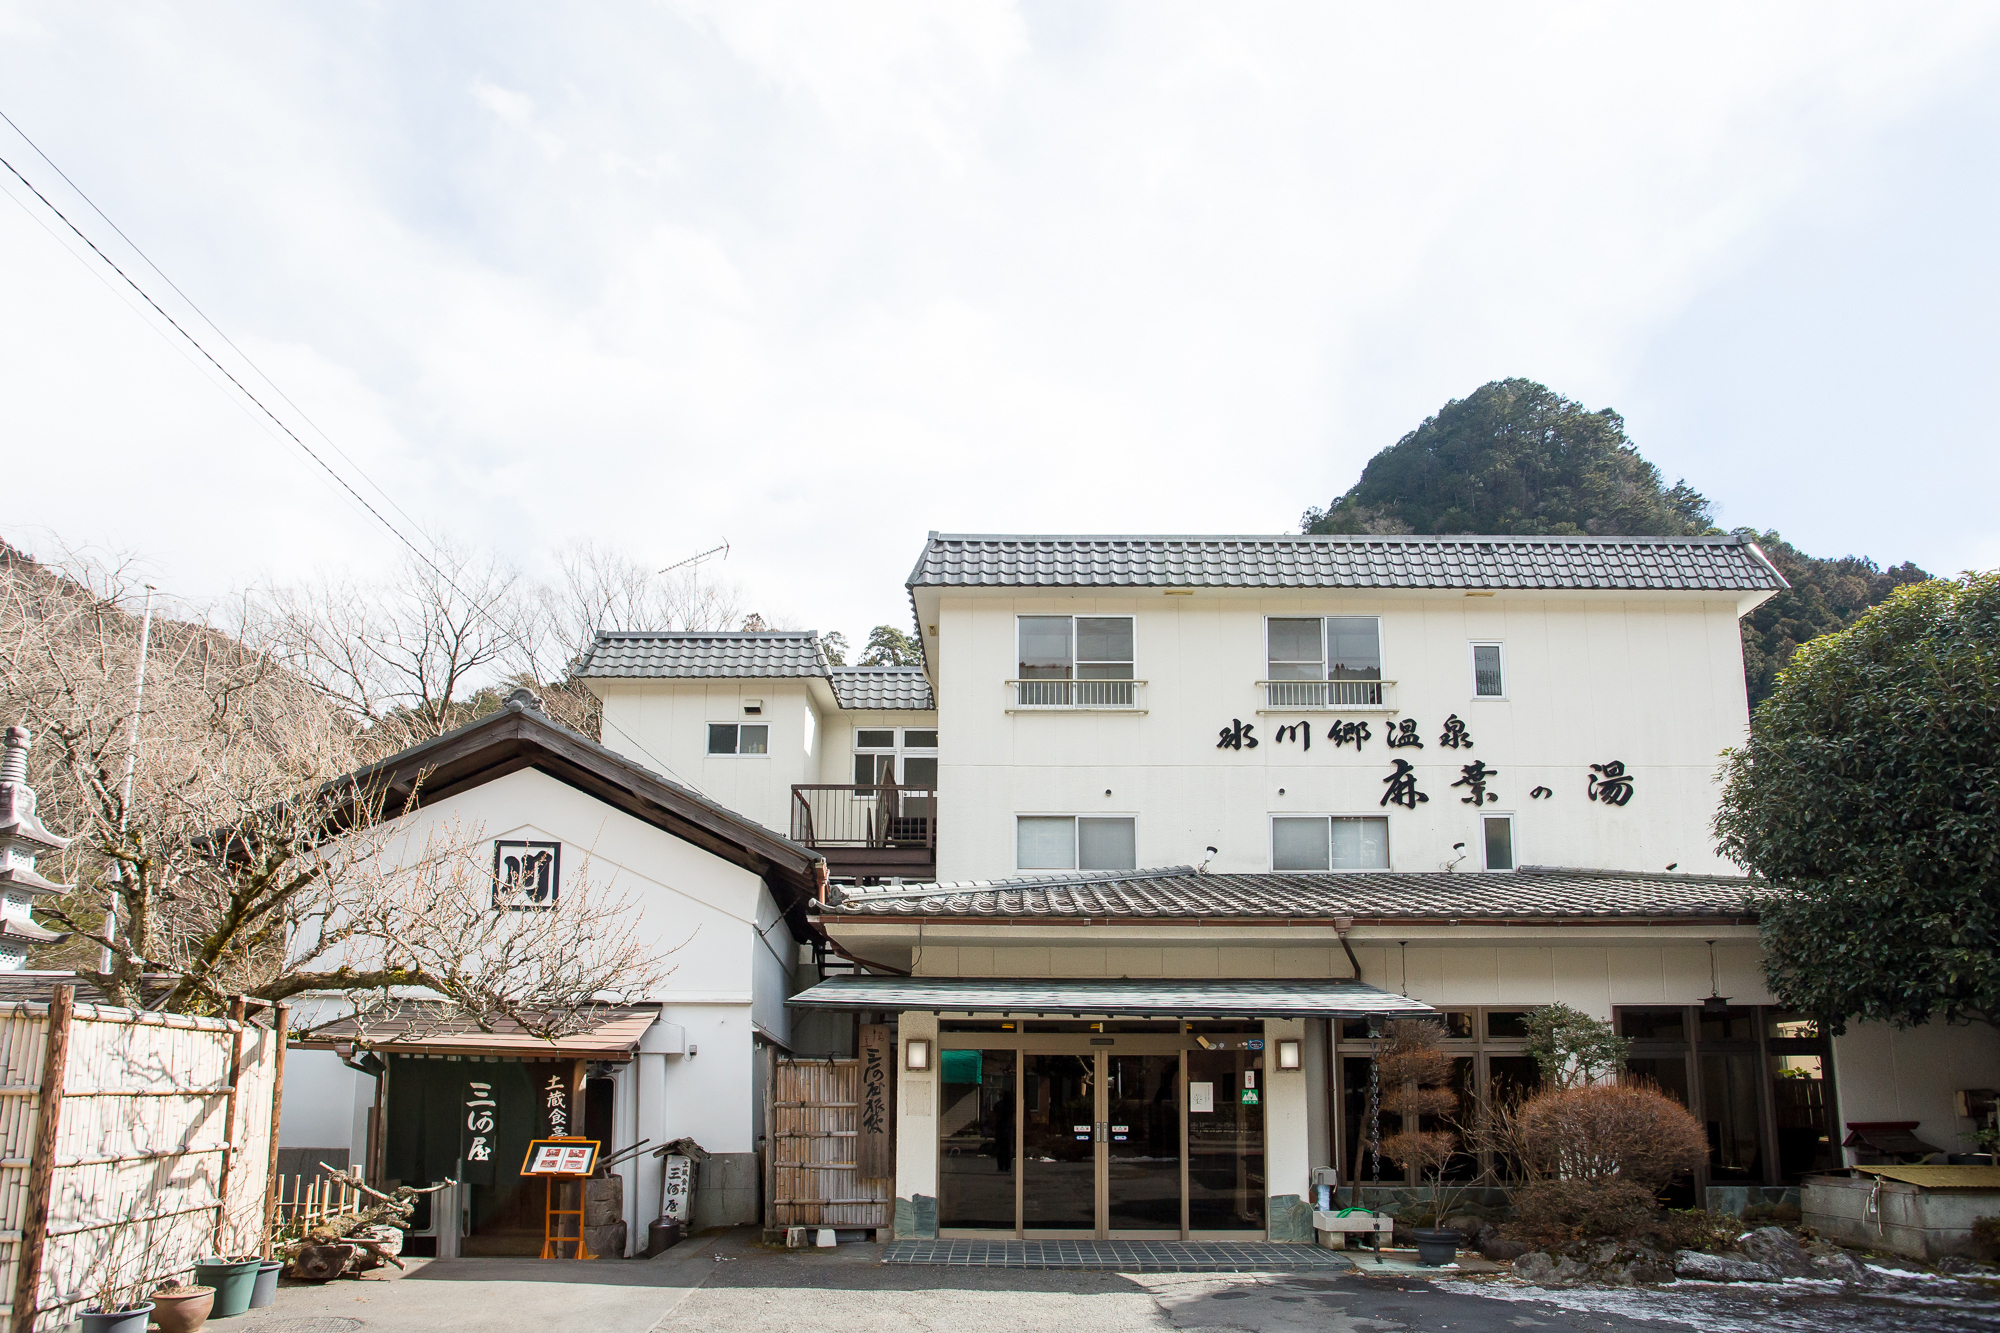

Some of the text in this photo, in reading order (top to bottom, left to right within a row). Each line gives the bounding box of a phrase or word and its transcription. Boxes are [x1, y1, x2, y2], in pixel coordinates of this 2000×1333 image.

[1216, 713, 1474, 752] 氷川郷温泉
[1380, 758, 1634, 810] 麻葉の湯
[466, 1081, 497, 1161] 三河屋
[664, 1166, 682, 1213] 三河屋
